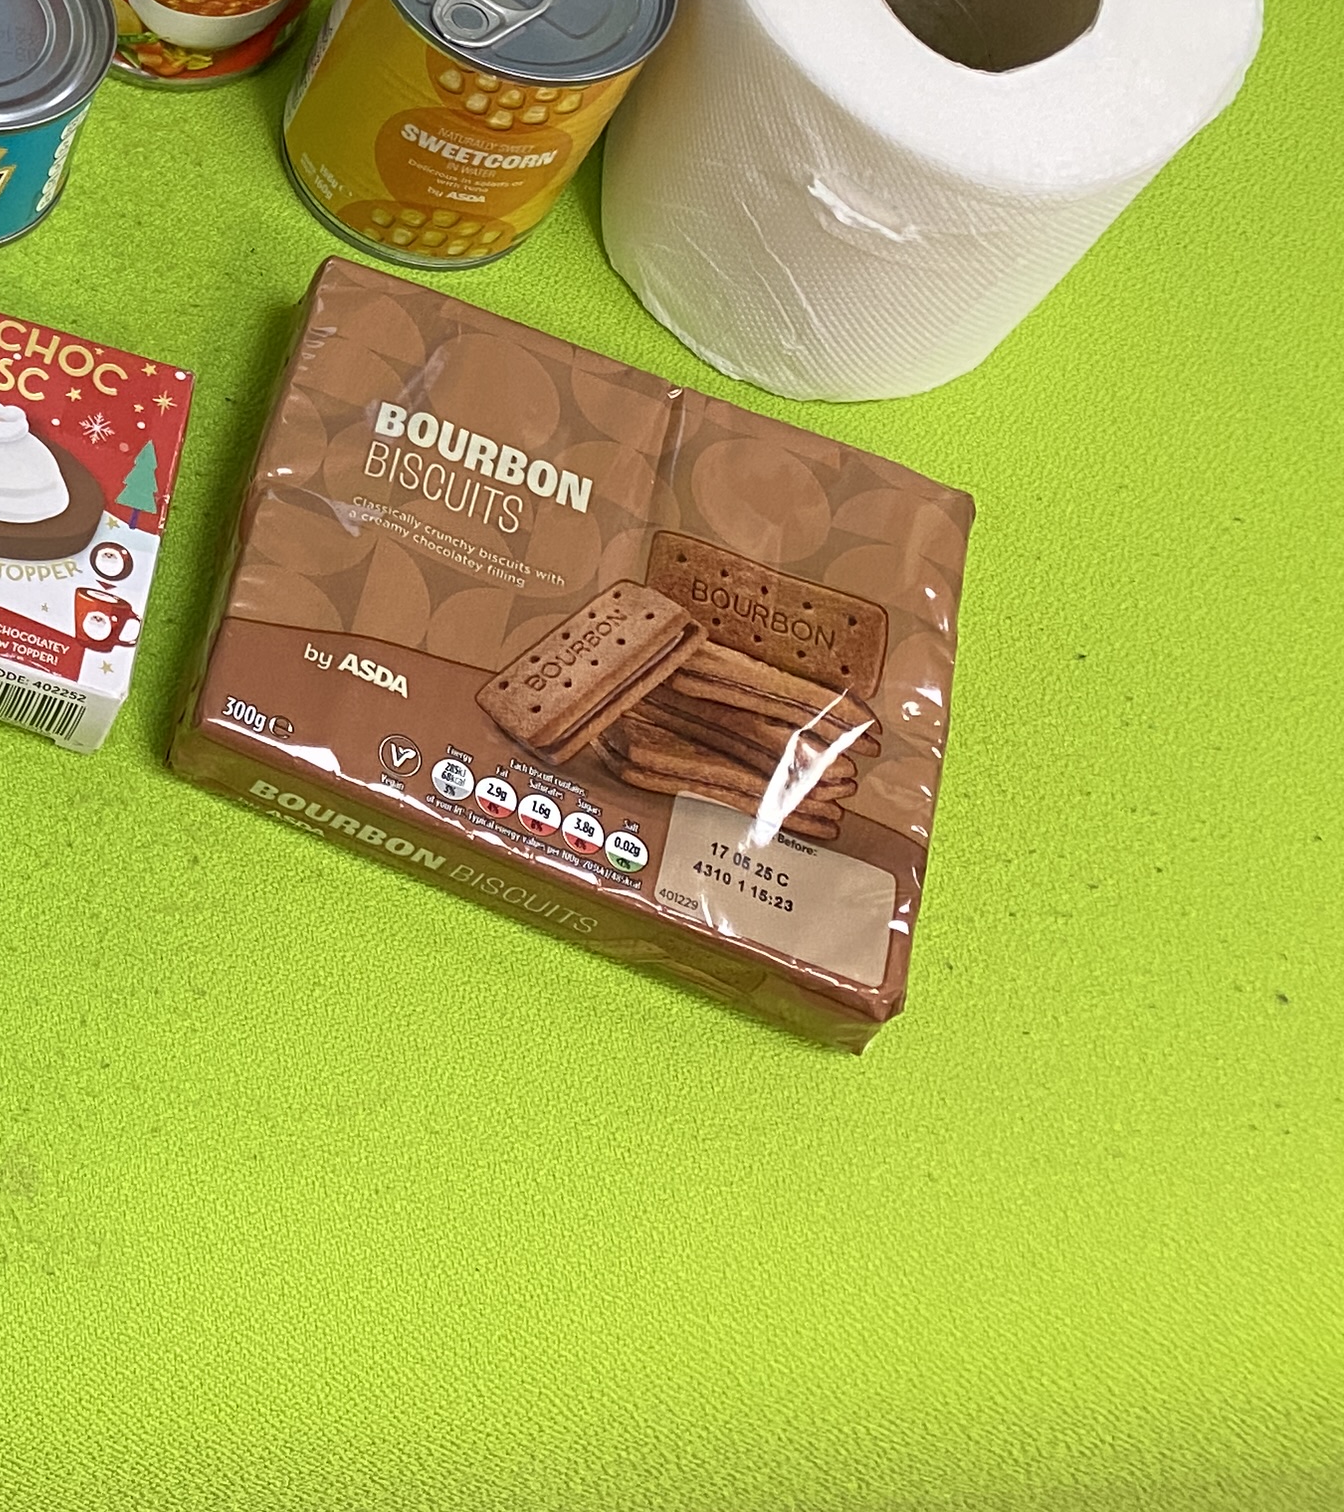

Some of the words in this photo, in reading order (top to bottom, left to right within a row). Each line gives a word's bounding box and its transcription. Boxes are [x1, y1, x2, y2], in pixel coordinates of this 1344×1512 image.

[401, 123, 558, 169] SWEETCORN
[447, 191, 486, 203] ASDA
[374, 402, 593, 513] BOURBON
[365, 441, 524, 533] BISCUITS
[353, 496, 422, 530] Classically
[424, 524, 476, 555] crunchy
[479, 546, 532, 576] biscuits
[535, 566, 566, 587] with
[360, 512, 410, 542] creamy
[413, 532, 486, 573] chocolatey
[487, 563, 526, 588] filling
[692, 579, 837, 651] BOURBON
[12, 641, 59, 666] TOPPER!
[304, 643, 333, 670] by
[337, 653, 410, 699] ASDA
[523, 607, 628, 692] BOURBON
[32, 679, 87, 702] 402252
[223, 697, 267, 734] 300g
[487, 783, 508, 802] 2.9g
[532, 800, 551, 819] 1.6g
[573, 817, 595, 837] 3.8g
[614, 836, 641, 857] 0.02g
[248, 778, 446, 871] BOURBON
[449, 865, 599, 934] BISCUITS
[659, 888, 700, 911] 401229
[694, 859, 732, 888] 4310
[750, 884, 795, 913] 15:23
